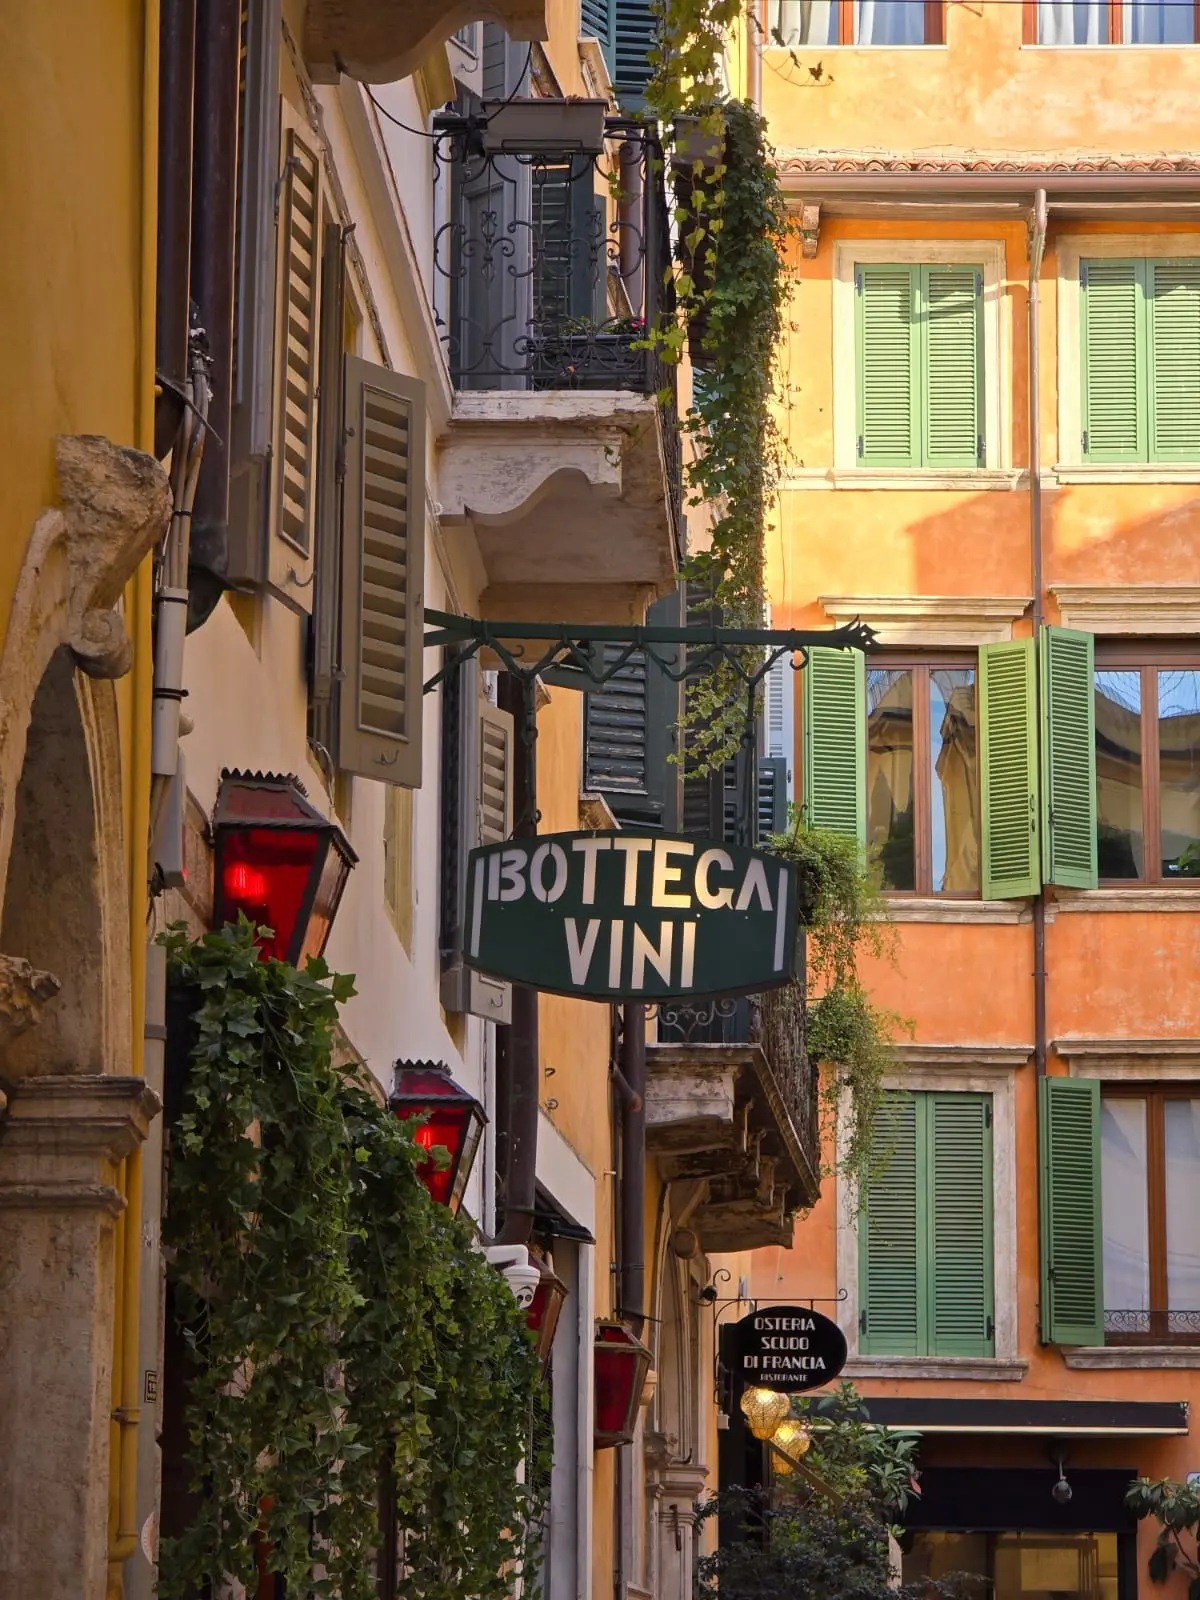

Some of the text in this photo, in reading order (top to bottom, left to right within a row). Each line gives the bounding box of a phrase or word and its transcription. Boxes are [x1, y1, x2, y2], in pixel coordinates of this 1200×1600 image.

[487, 837, 773, 911] BOTTEGA
[564, 918, 697, 990] VINI
[754, 1317, 816, 1331] OSTERIA
[761, 1336, 809, 1350] SCUDO
[743, 1355, 826, 1370] DI FRANCIA
[760, 1373, 808, 1382] RISTORANTE
